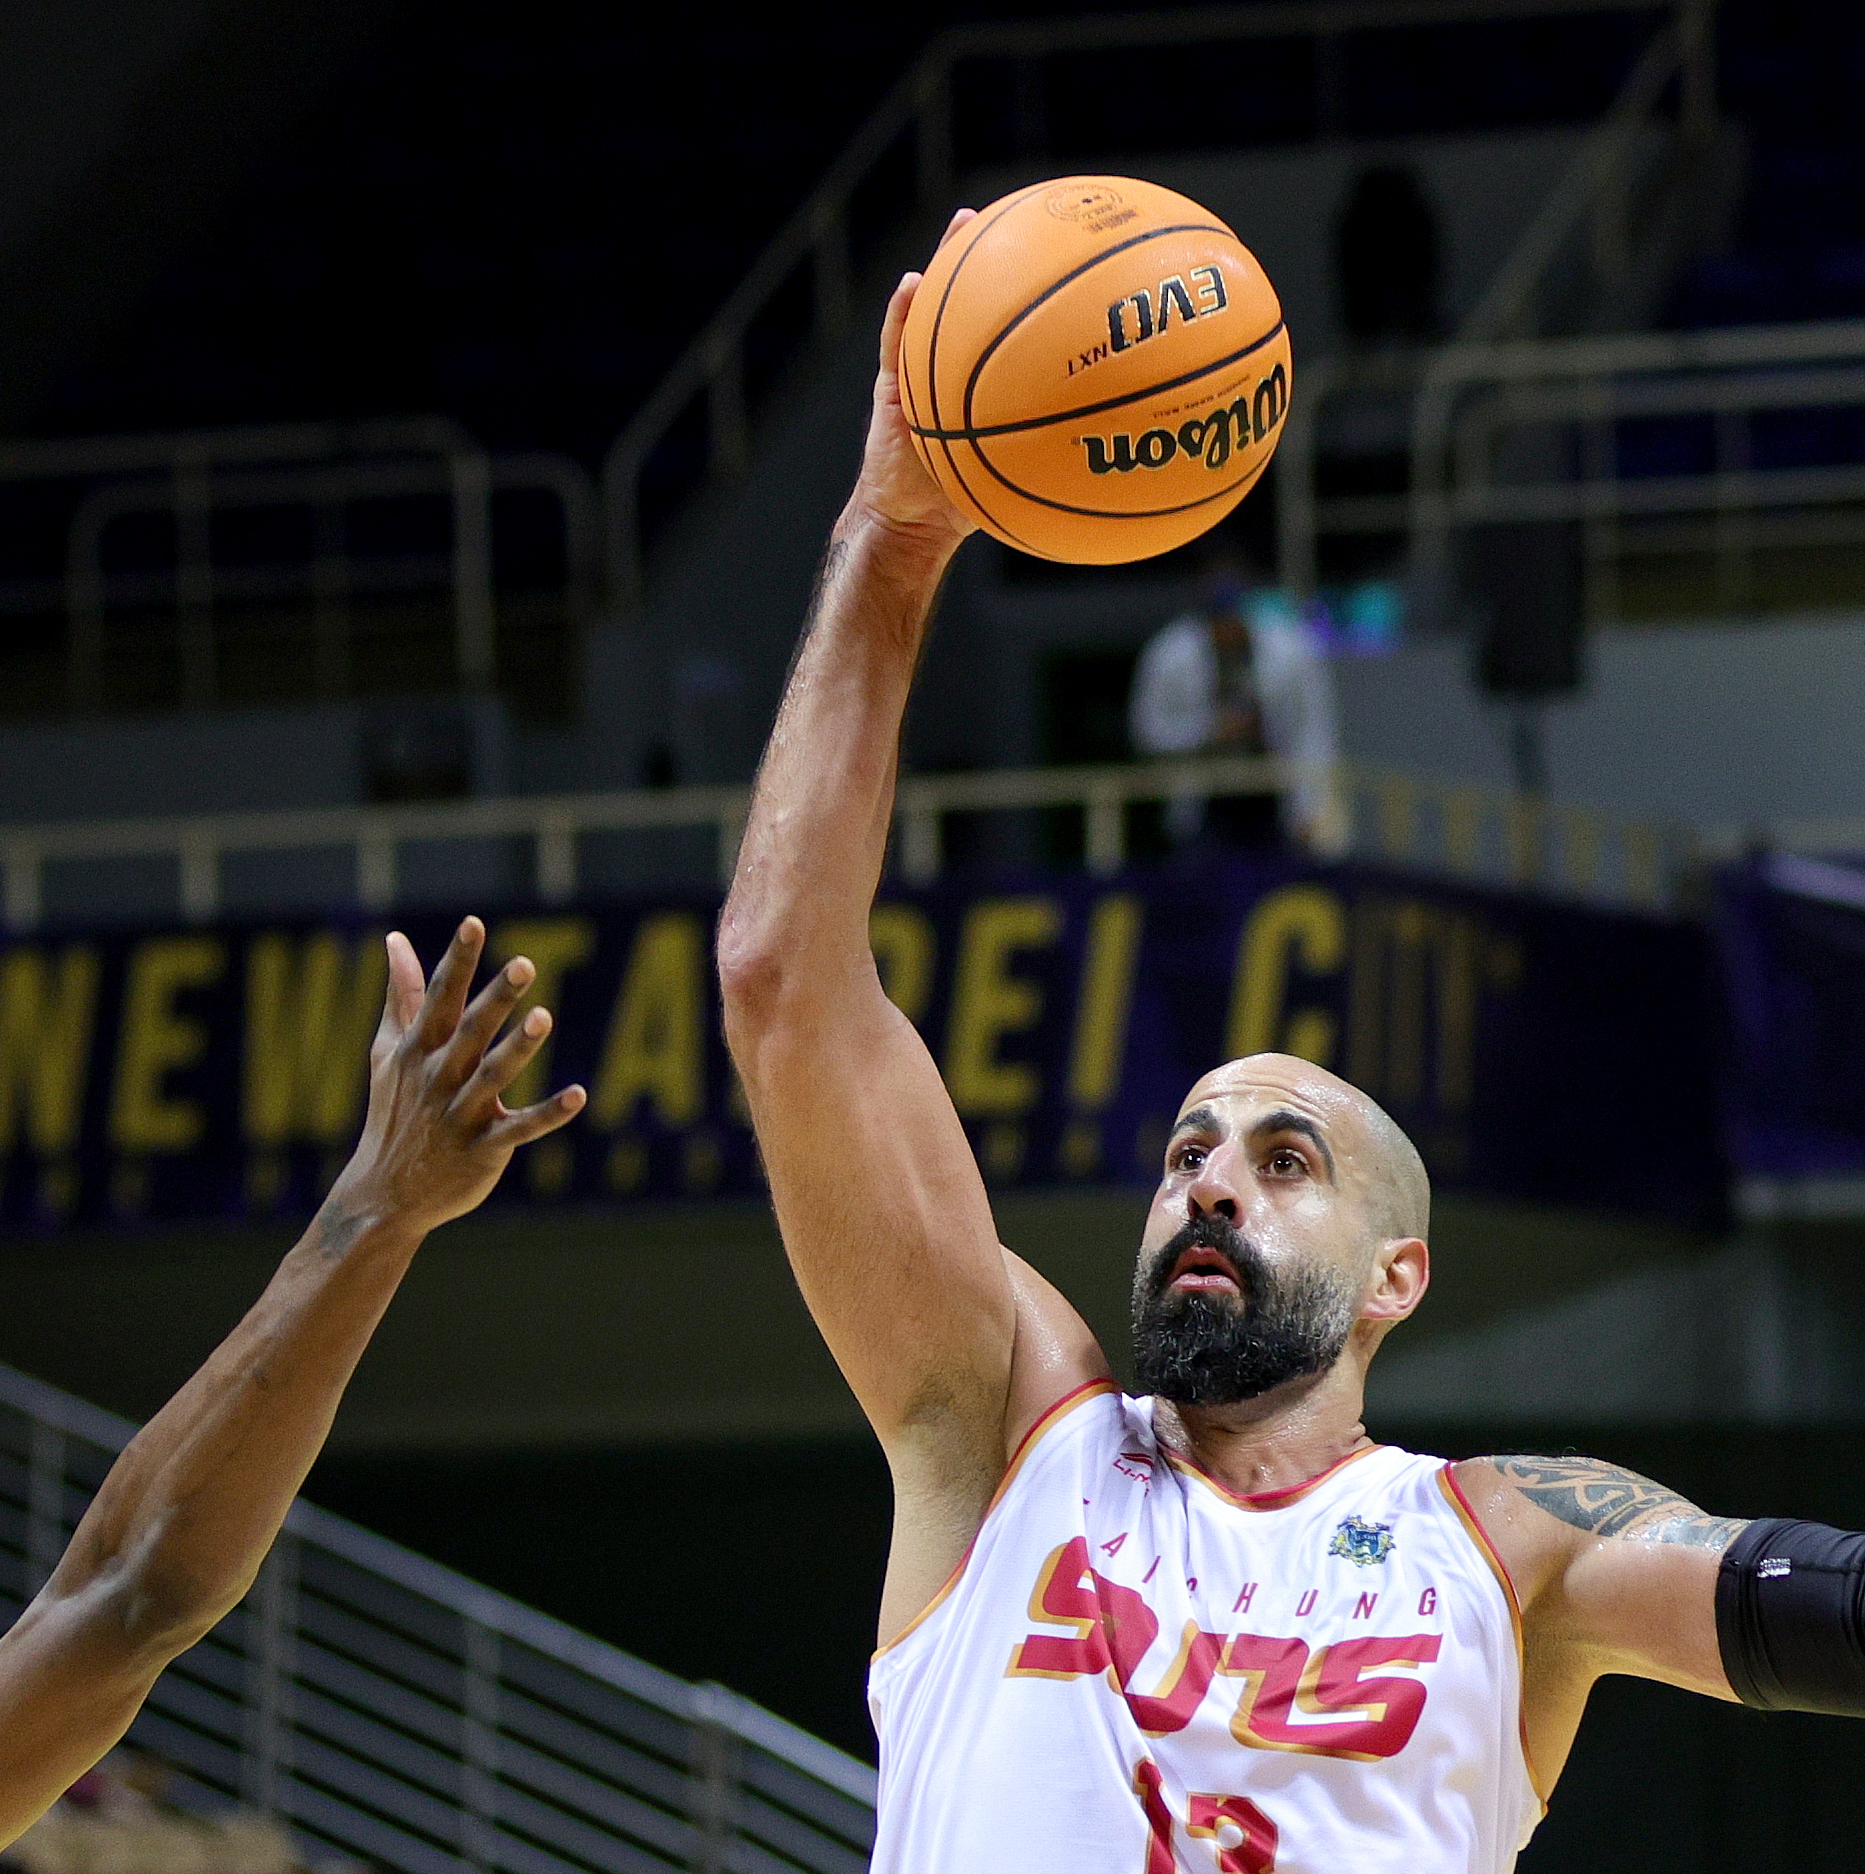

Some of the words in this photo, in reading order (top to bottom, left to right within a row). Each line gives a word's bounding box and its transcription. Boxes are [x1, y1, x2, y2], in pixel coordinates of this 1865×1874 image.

[1066, 343, 1108, 377] NXT
[1105, 262, 1228, 356] EVO
[1082, 362, 1288, 476] Wilson
[1004, 1536, 1443, 1763] SUNS
